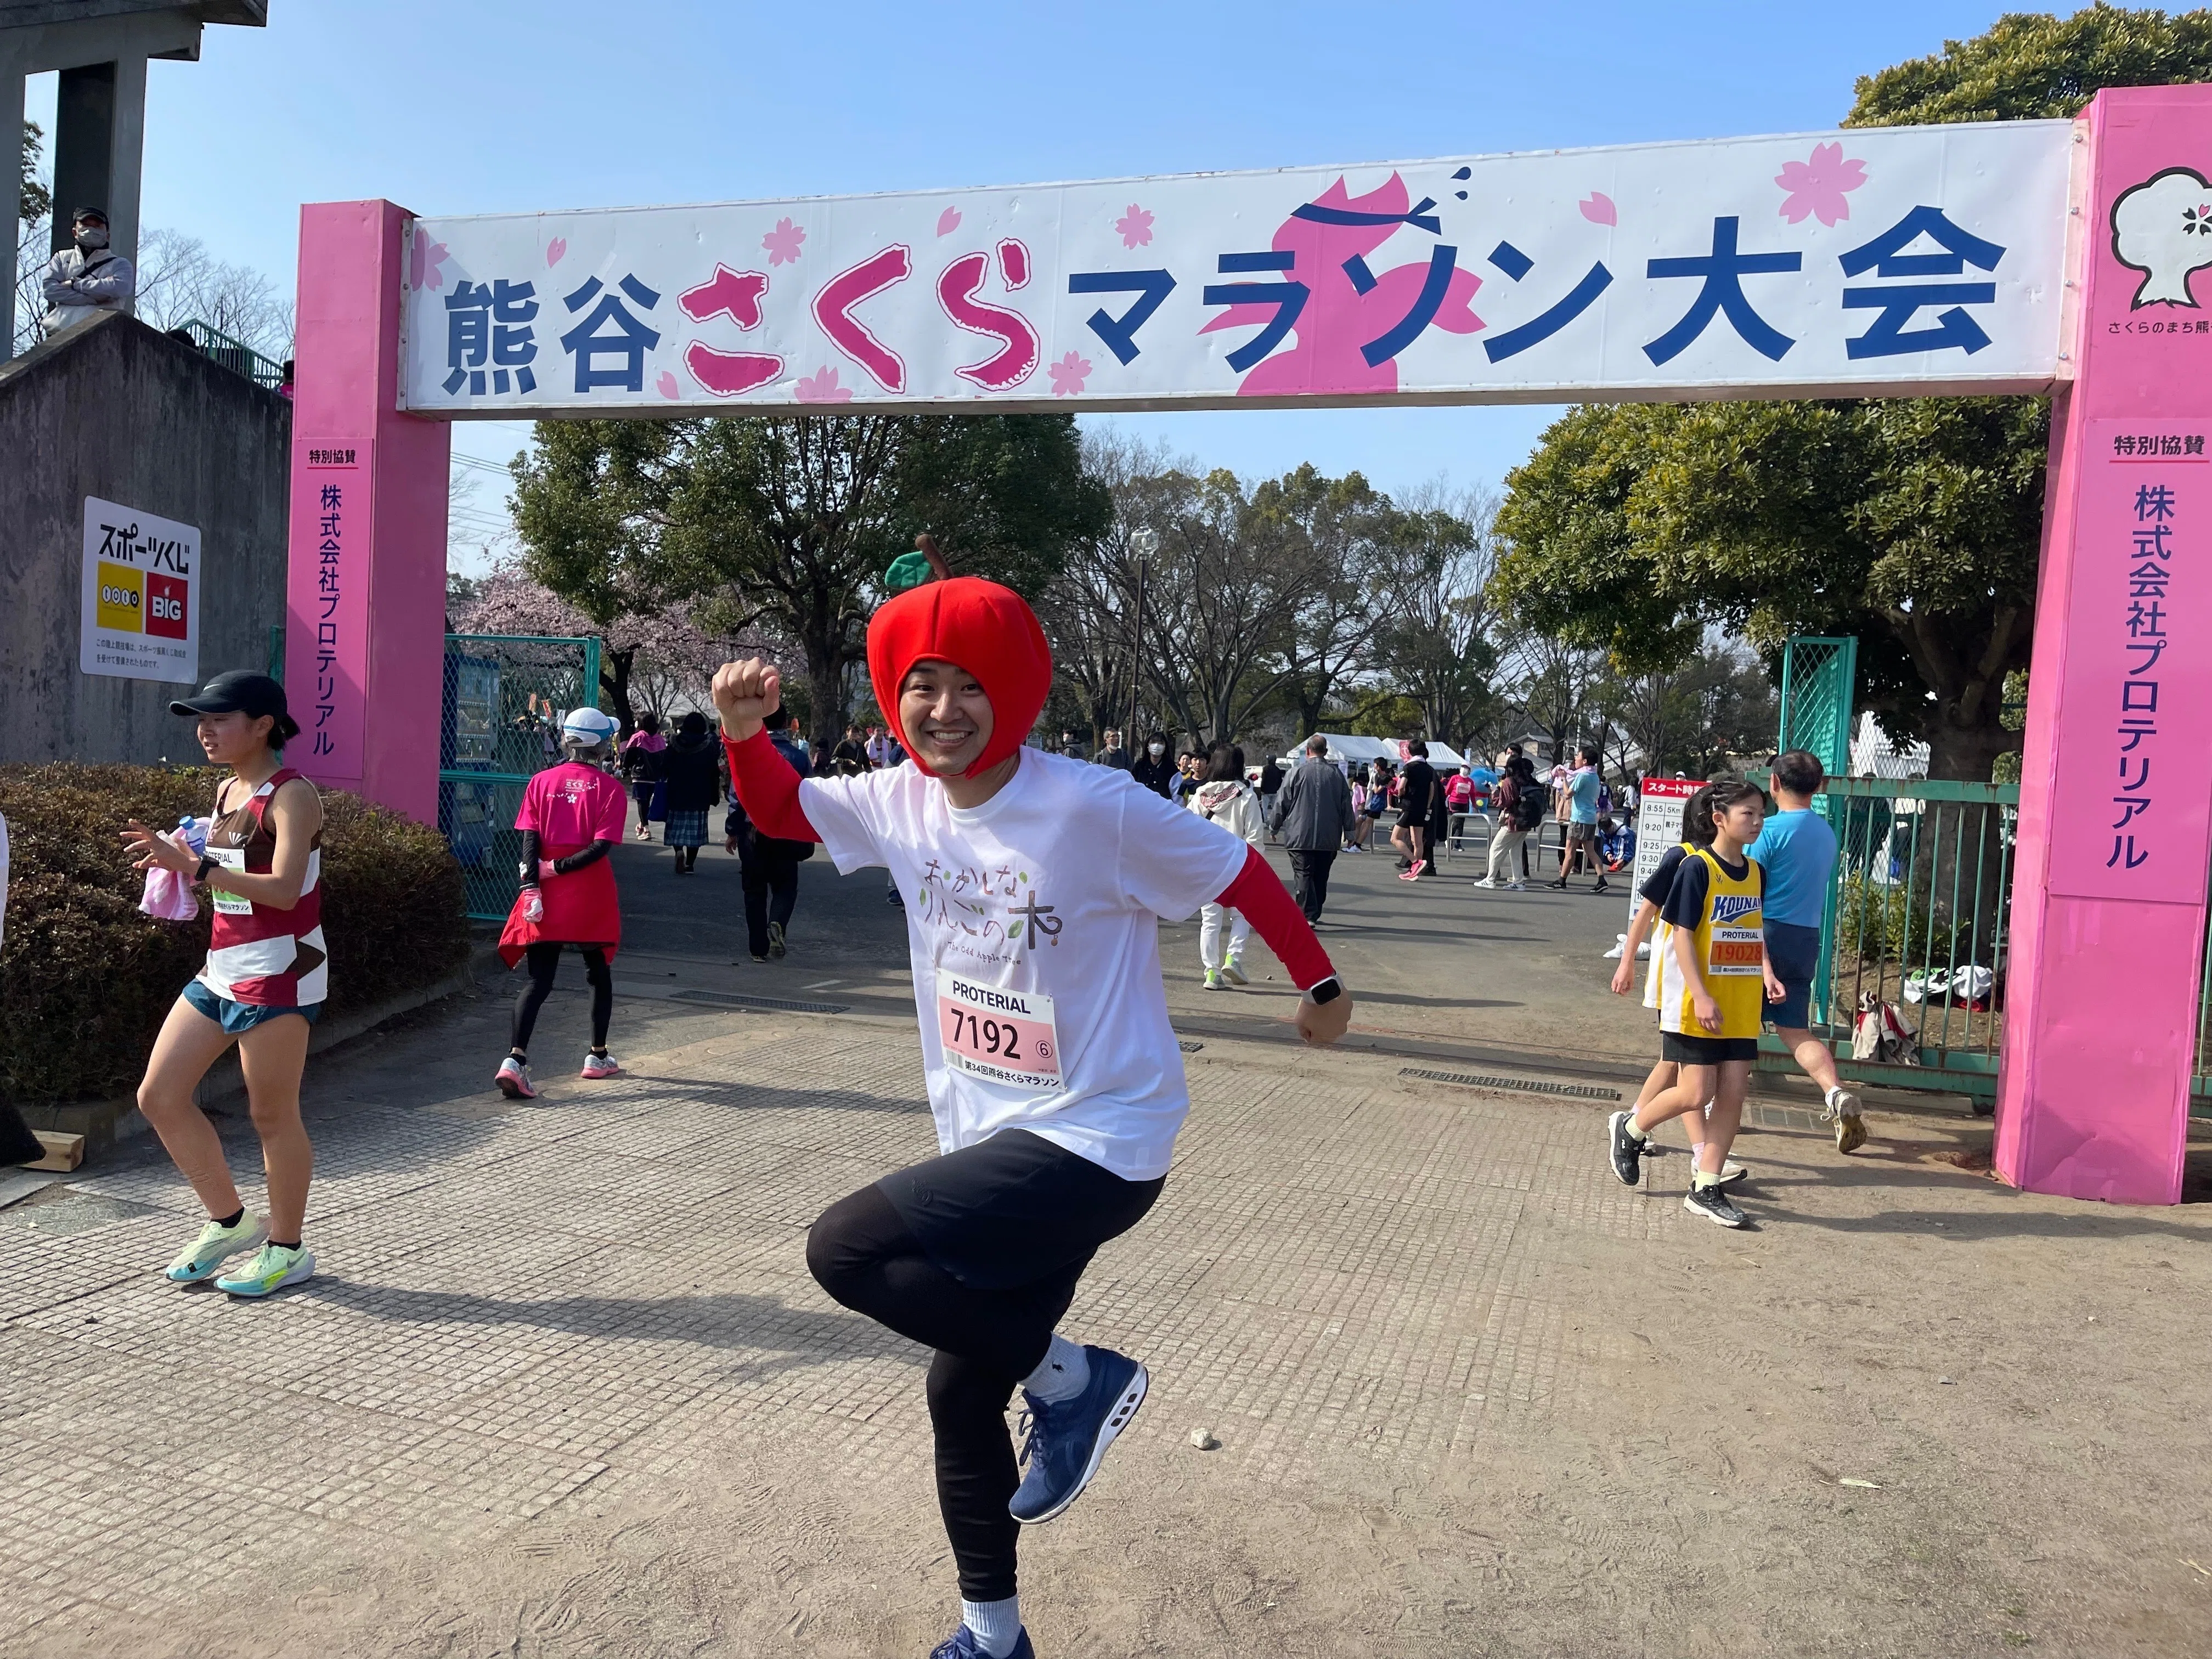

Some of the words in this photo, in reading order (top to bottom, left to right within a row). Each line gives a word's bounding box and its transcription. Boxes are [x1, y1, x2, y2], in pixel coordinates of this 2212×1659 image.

[441, 205, 2007, 396] 熊谷さくらマラソン大会
[2108, 320, 2212, 334] さくらのまち熊
[309, 449, 356, 464] 特別協賛
[2113, 436, 2205, 456] 特別協賛
[99, 522, 190, 574] スポーツくじ
[102, 584, 139, 608] toto
[152, 596, 182, 620] BIG
[313, 484, 342, 756] 株式会社プロテリアル
[2106, 484, 2175, 870] 株式会社プロテリアル
[1722, 931, 1759, 939] PROTERIAL
[947, 941, 958, 951] The
[961, 946, 974, 957] Odd
[977, 950, 1000, 963] Apple
[952, 980, 1031, 1014] PROTERIAL
[950, 1007, 1021, 1059] 7192
[964, 1060, 1059, 1087] 第34回熊谷さくらマラソン
